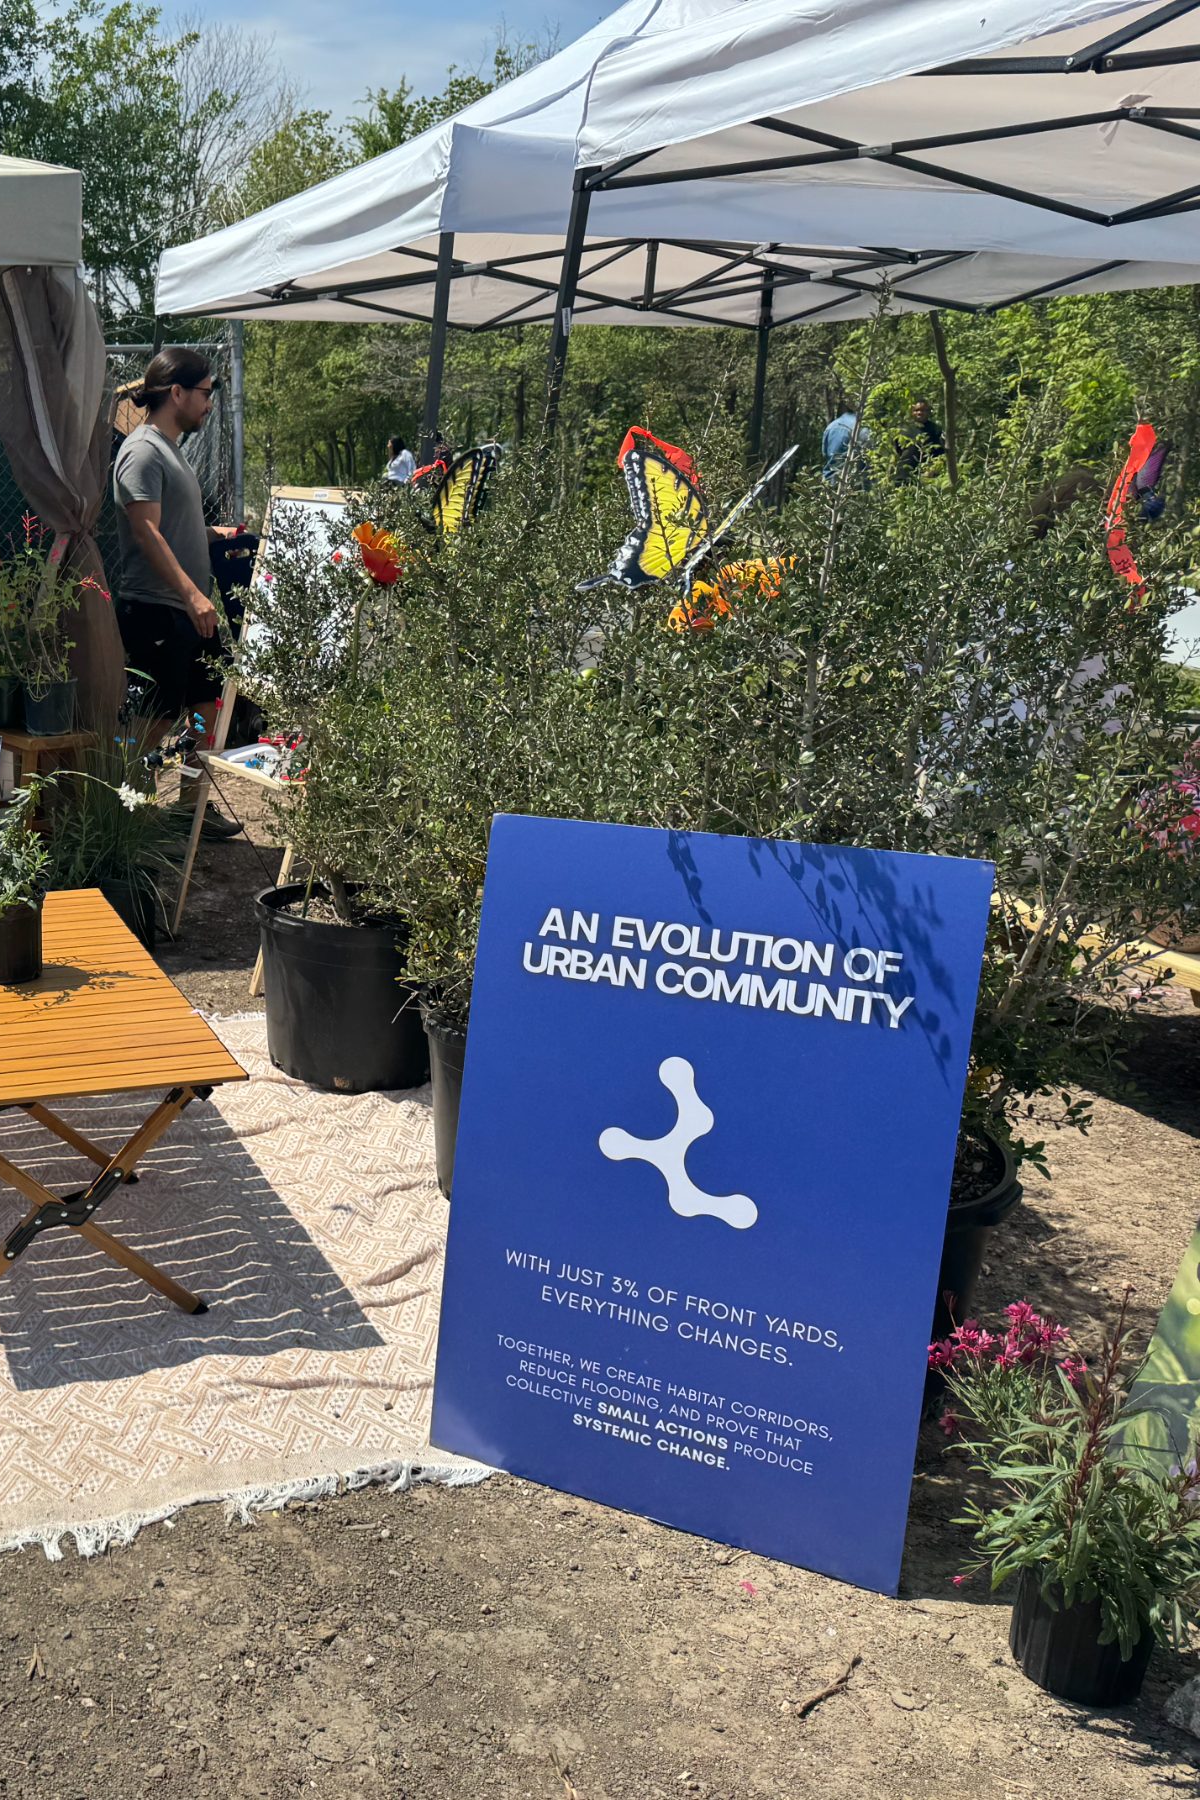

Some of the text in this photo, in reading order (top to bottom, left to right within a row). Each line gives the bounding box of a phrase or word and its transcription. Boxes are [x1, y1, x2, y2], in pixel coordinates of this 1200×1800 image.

[522, 942, 915, 1029] URBAN COMMUNITY
[538, 907, 903, 984] AN EVOLUTION OF
[506, 1249, 843, 1353] WITH JUST 3% OF FRONT YARDS,
[541, 1285, 793, 1367] EVERYTHING CHANGES.
[496, 1334, 833, 1442] TOGETHER, WE CREATE HABITAT CORRIDORS,
[506, 1374, 814, 1475] COLLECTIVE SMALL ACTIONS PRODUCE
[519, 1359, 803, 1451] REDUCE FLOODING, AND PROVE THAT
[572, 1413, 731, 1471] SYSTEMIC CHANGE.
